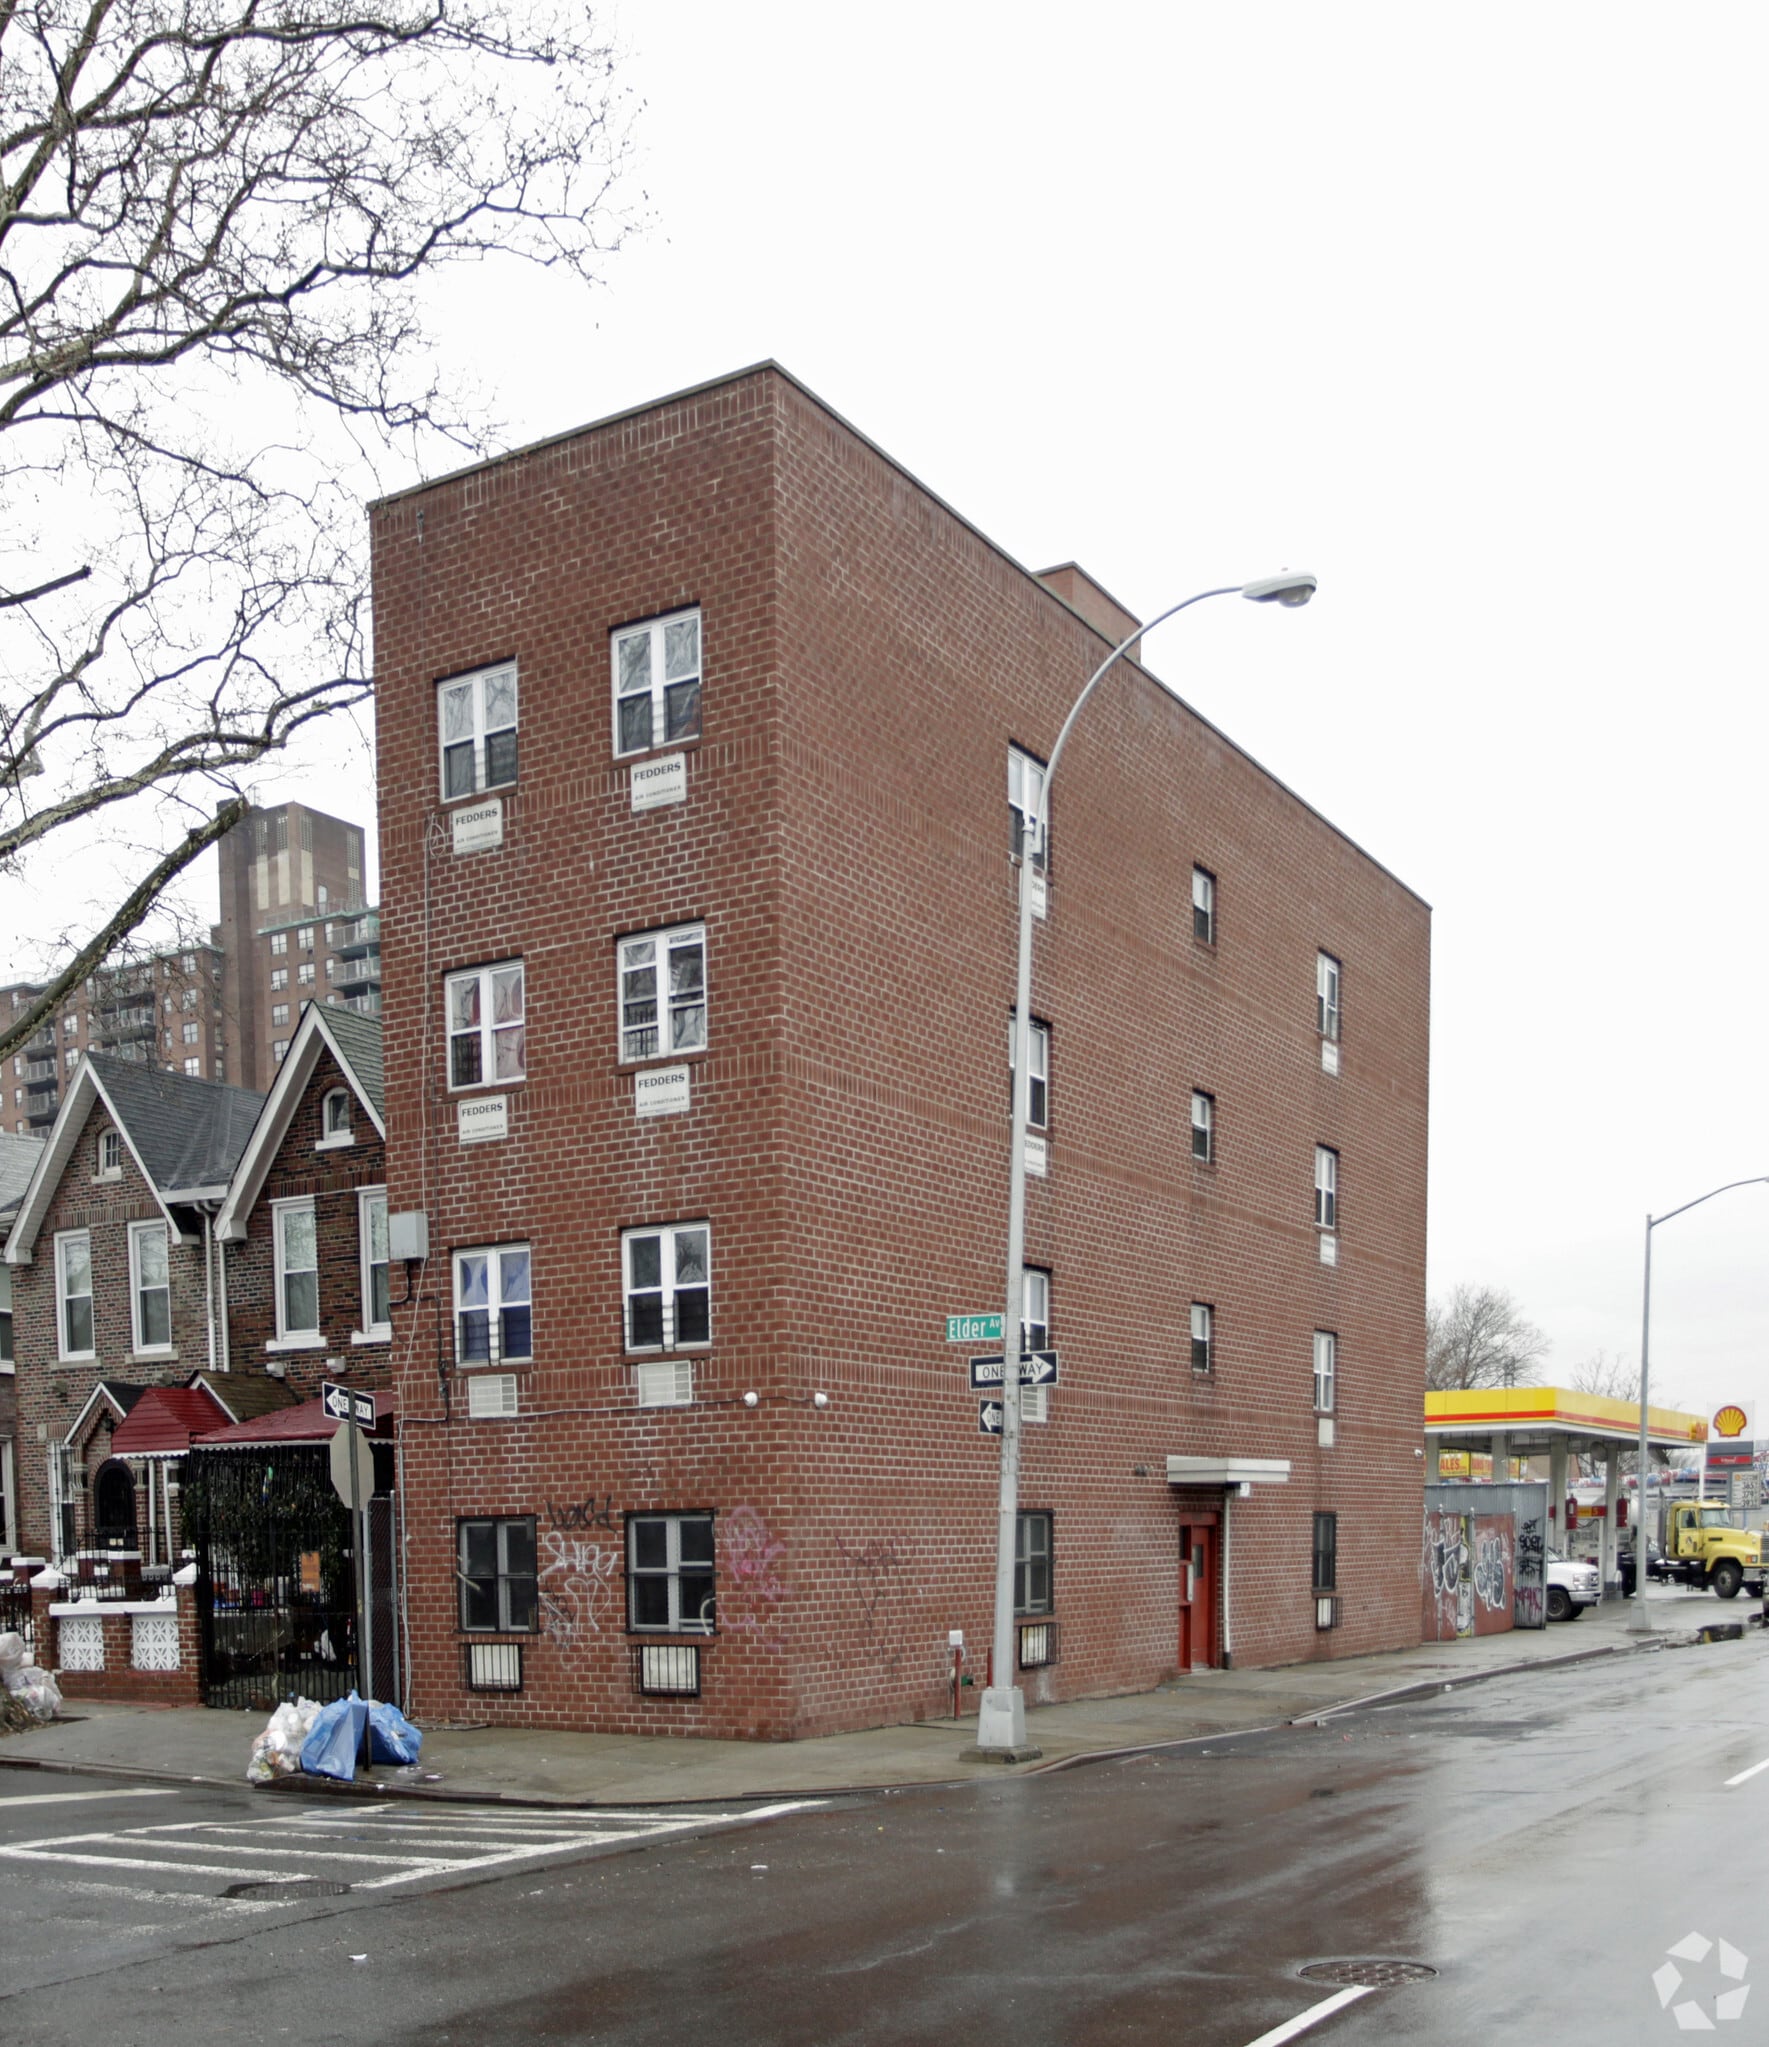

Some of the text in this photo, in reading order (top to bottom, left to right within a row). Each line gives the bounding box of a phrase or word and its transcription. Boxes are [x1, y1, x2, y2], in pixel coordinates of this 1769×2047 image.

[633, 761, 681, 782] FEDDERS
[455, 807, 498, 826] FEDDERS
[638, 1073, 685, 1089] FEDDERS
[462, 1102, 503, 1117] FEDDERS
[949, 1319, 986, 1339] Elder
[982, 1363, 1044, 1379] ONE WAY
[332, 1395, 348, 1411] ONE
